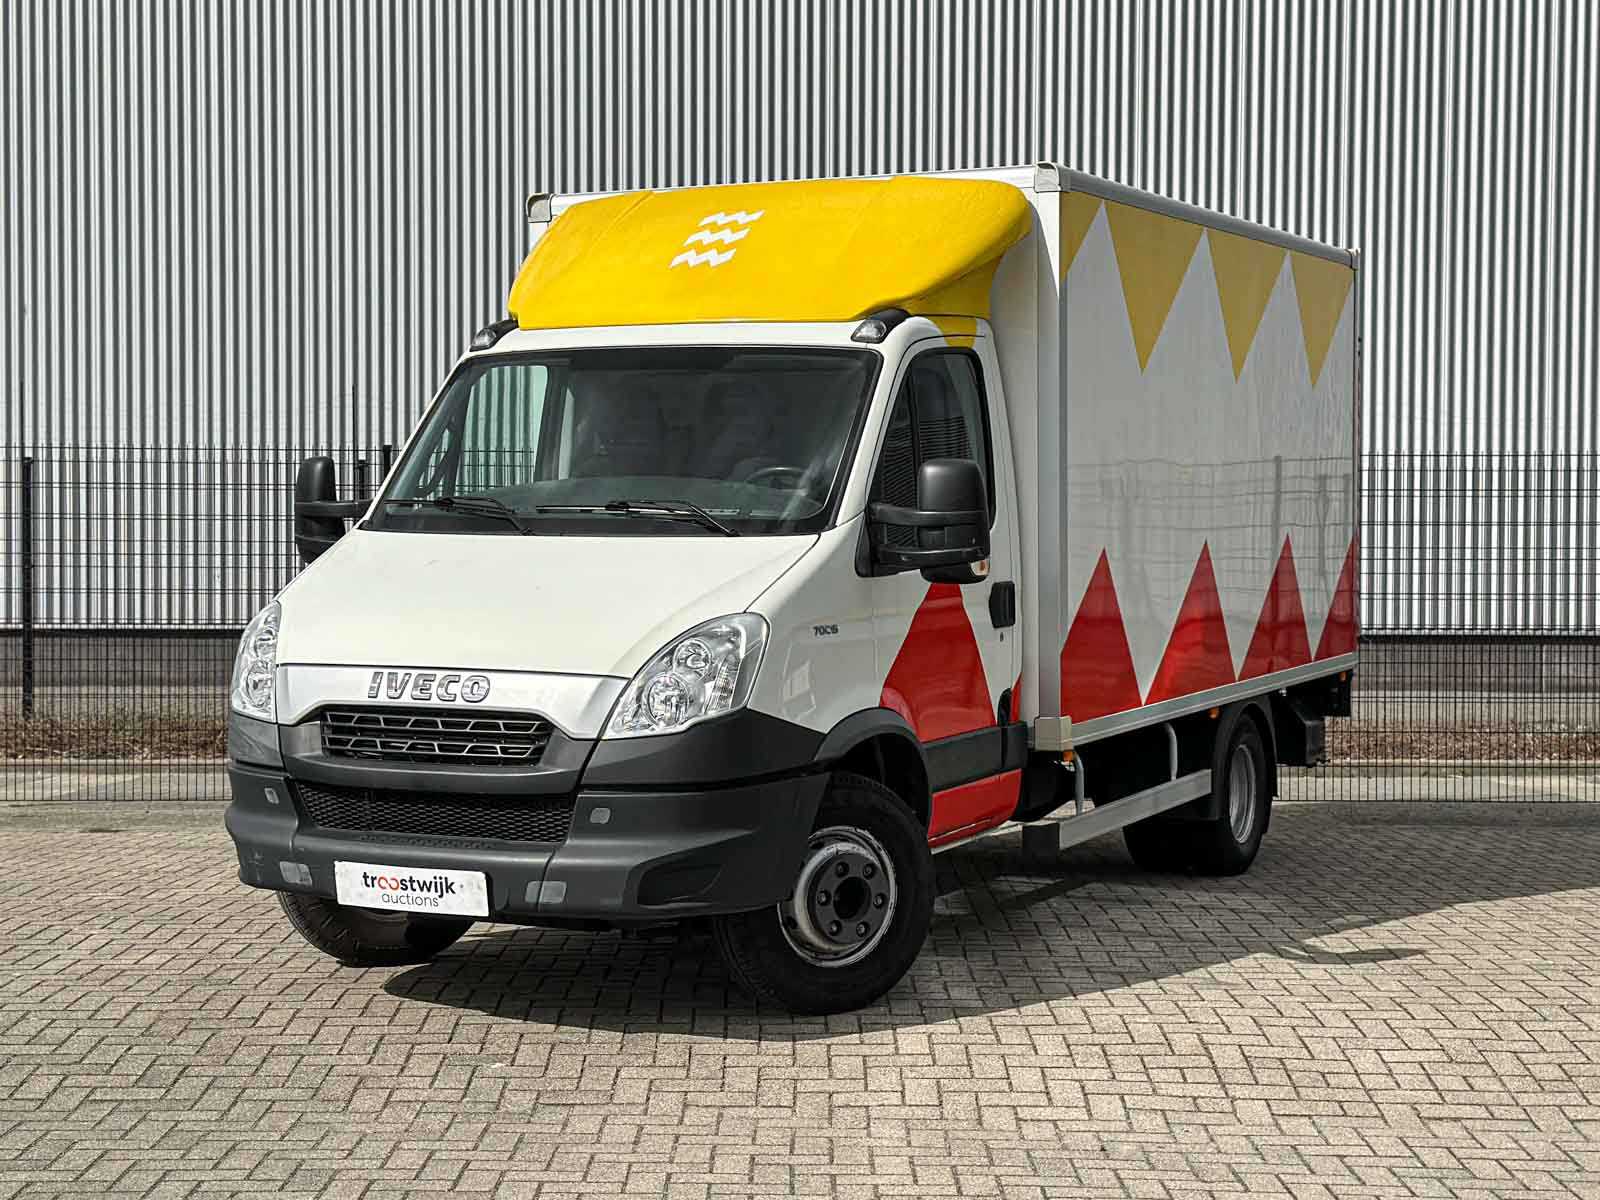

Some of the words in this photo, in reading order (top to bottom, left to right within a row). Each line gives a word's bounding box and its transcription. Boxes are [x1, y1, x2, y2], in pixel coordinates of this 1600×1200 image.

[367, 671, 491, 703] IVECO
[362, 871, 456, 899] troostwijk
[381, 892, 439, 907] auctions
